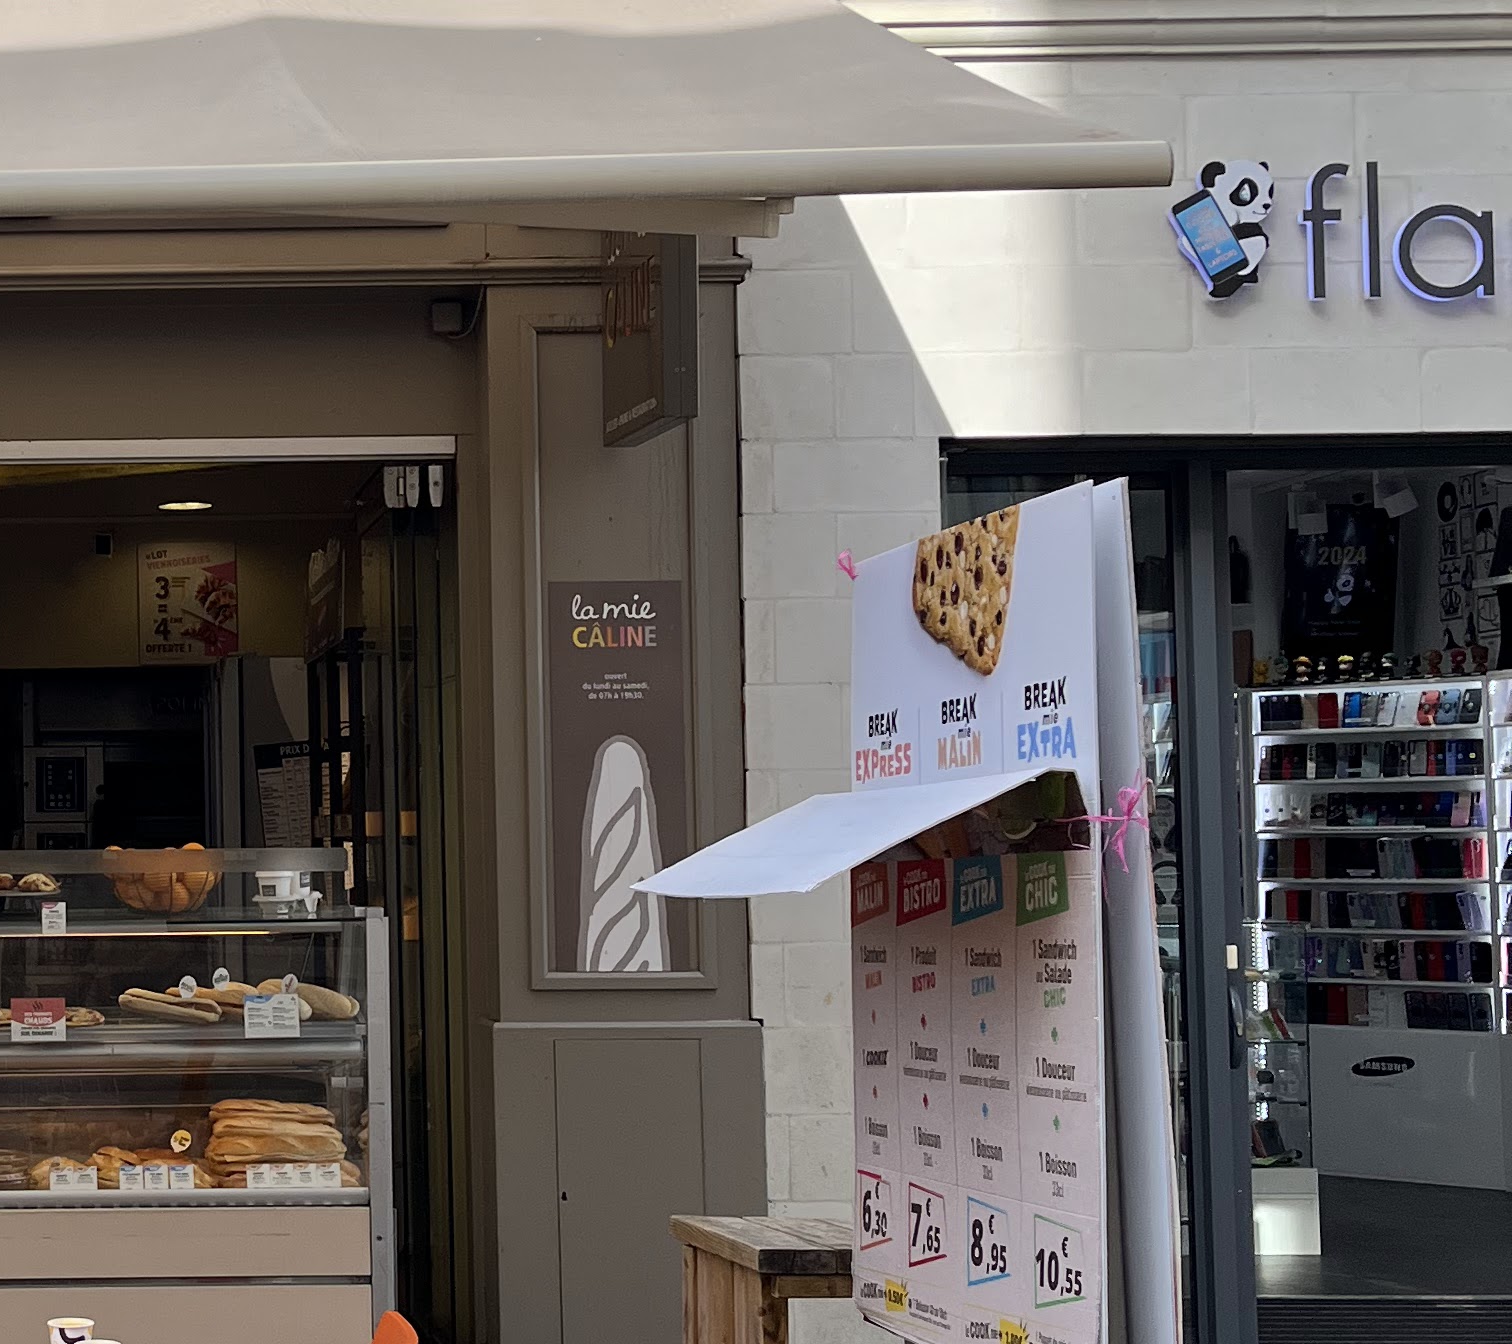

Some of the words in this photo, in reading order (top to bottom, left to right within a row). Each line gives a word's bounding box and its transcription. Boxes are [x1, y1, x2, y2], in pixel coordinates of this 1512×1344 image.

[151, 549, 168, 560] LOT
[1318, 546, 1369, 567] 2024
[155, 576, 170, 600] 3
[571, 593, 600, 621] la
[602, 593, 657, 620] mie
[571, 621, 658, 649] CÂLINE
[593, 682, 612, 690] lundi
[604, 672, 628, 681] ouvert
[1024, 675, 1067, 710] BREAK
[941, 692, 977, 725] BREAK
[868, 708, 899, 738] BREAK
[903, 878, 941, 913] BISTRO
[960, 876, 998, 913] EXTRA
[1025, 876, 1059, 912] CHIC
[1037, 938, 1077, 960] Sandwich
[1044, 962, 1072, 984] Salade
[1043, 986, 1067, 1009] CHIC
[1041, 1057, 1076, 1082] Douceur
[1358, 1060, 1409, 1072] SAMSUNG
[976, 1137, 1003, 1163] Boisson
[1045, 1152, 1077, 1179] Boisson
[969, 1321, 991, 1340] COOK
